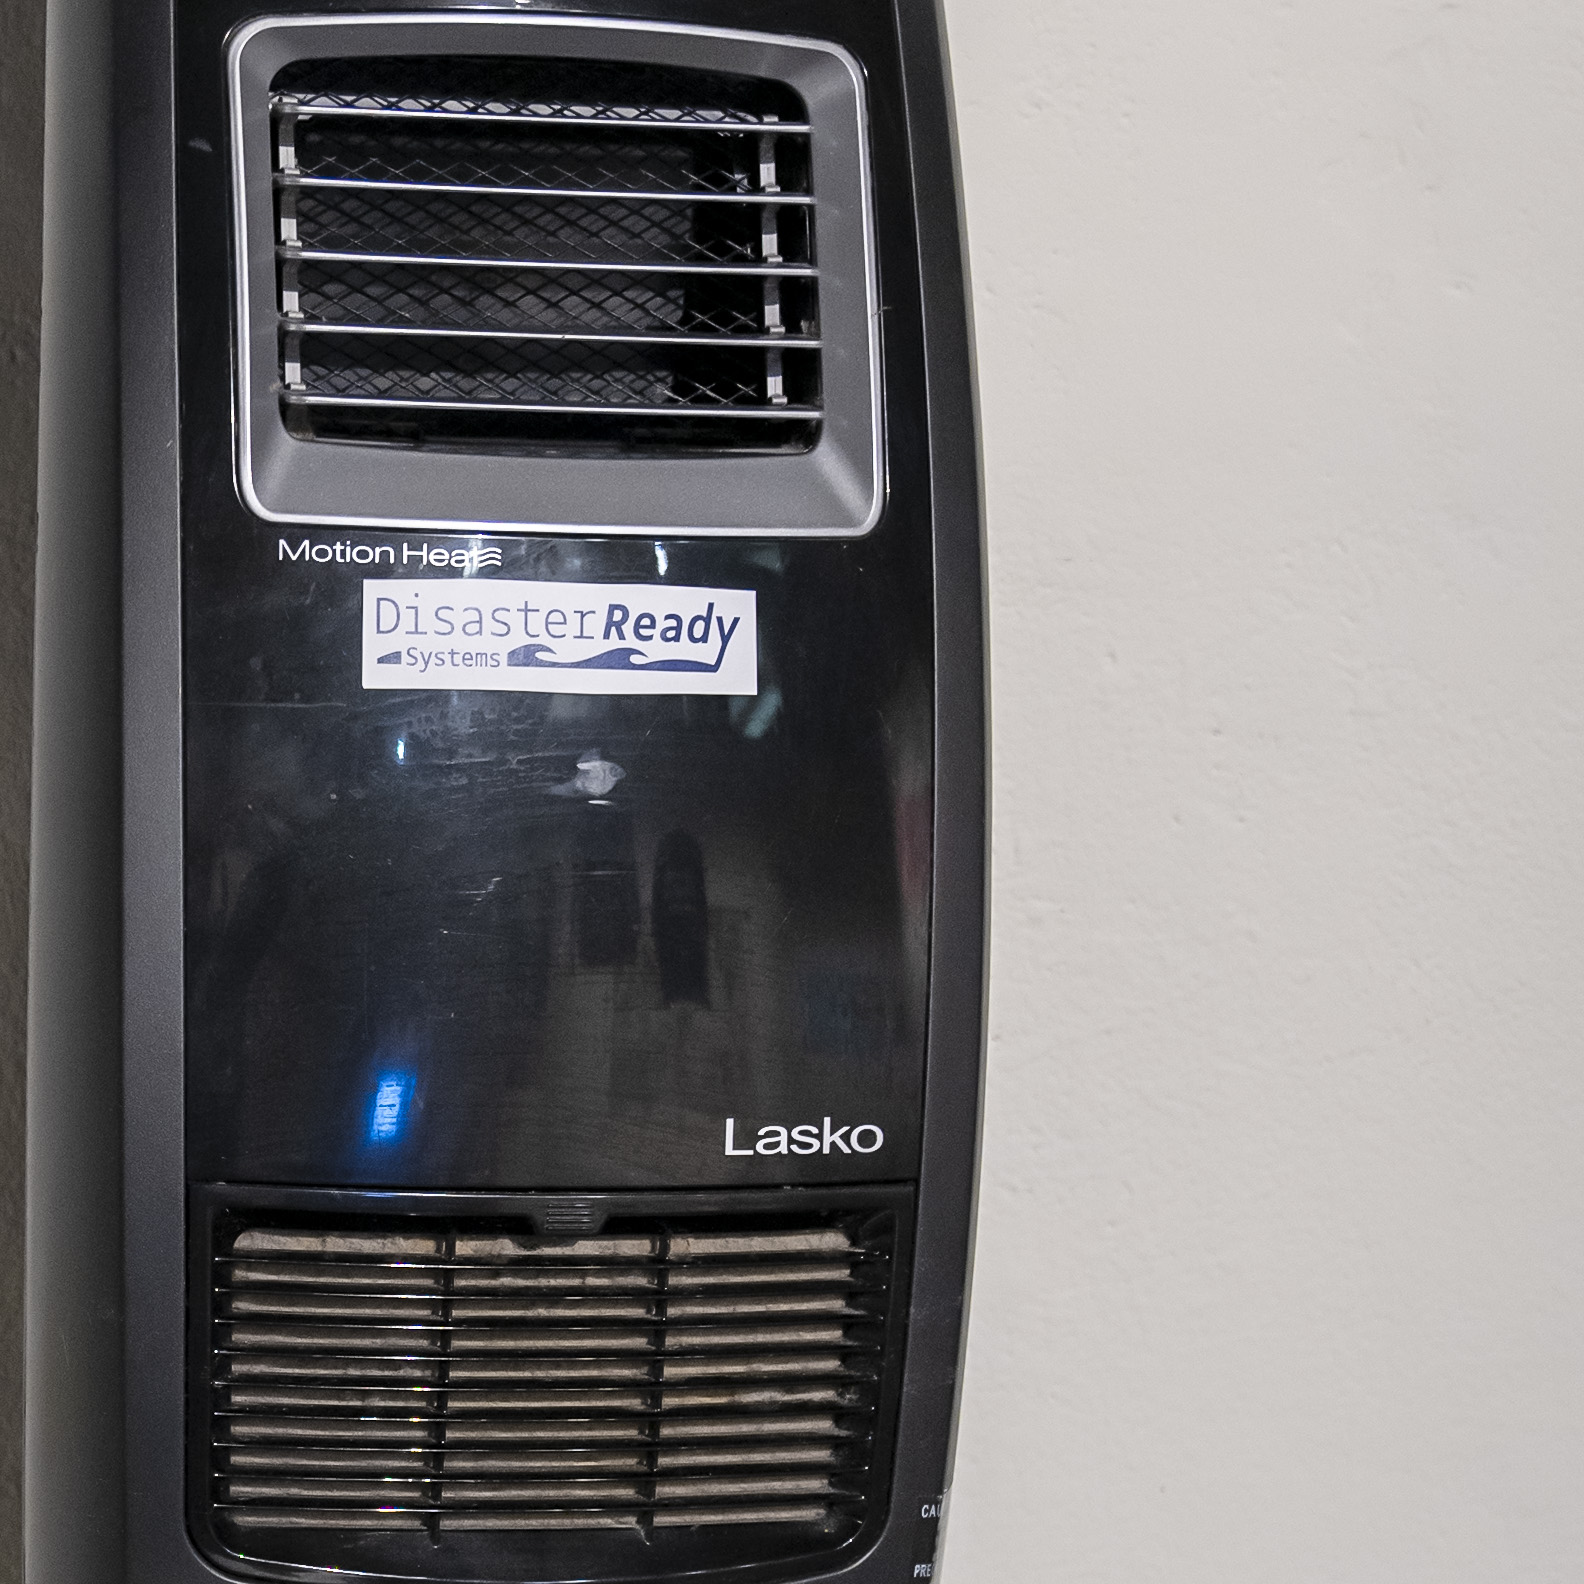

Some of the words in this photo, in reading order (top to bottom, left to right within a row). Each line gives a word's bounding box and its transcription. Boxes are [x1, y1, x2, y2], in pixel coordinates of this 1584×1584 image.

[278, 538, 395, 564] Motion
[402, 542, 481, 568] Heat
[405, 646, 502, 674] Systems
[724, 1116, 885, 1156] Lasko
